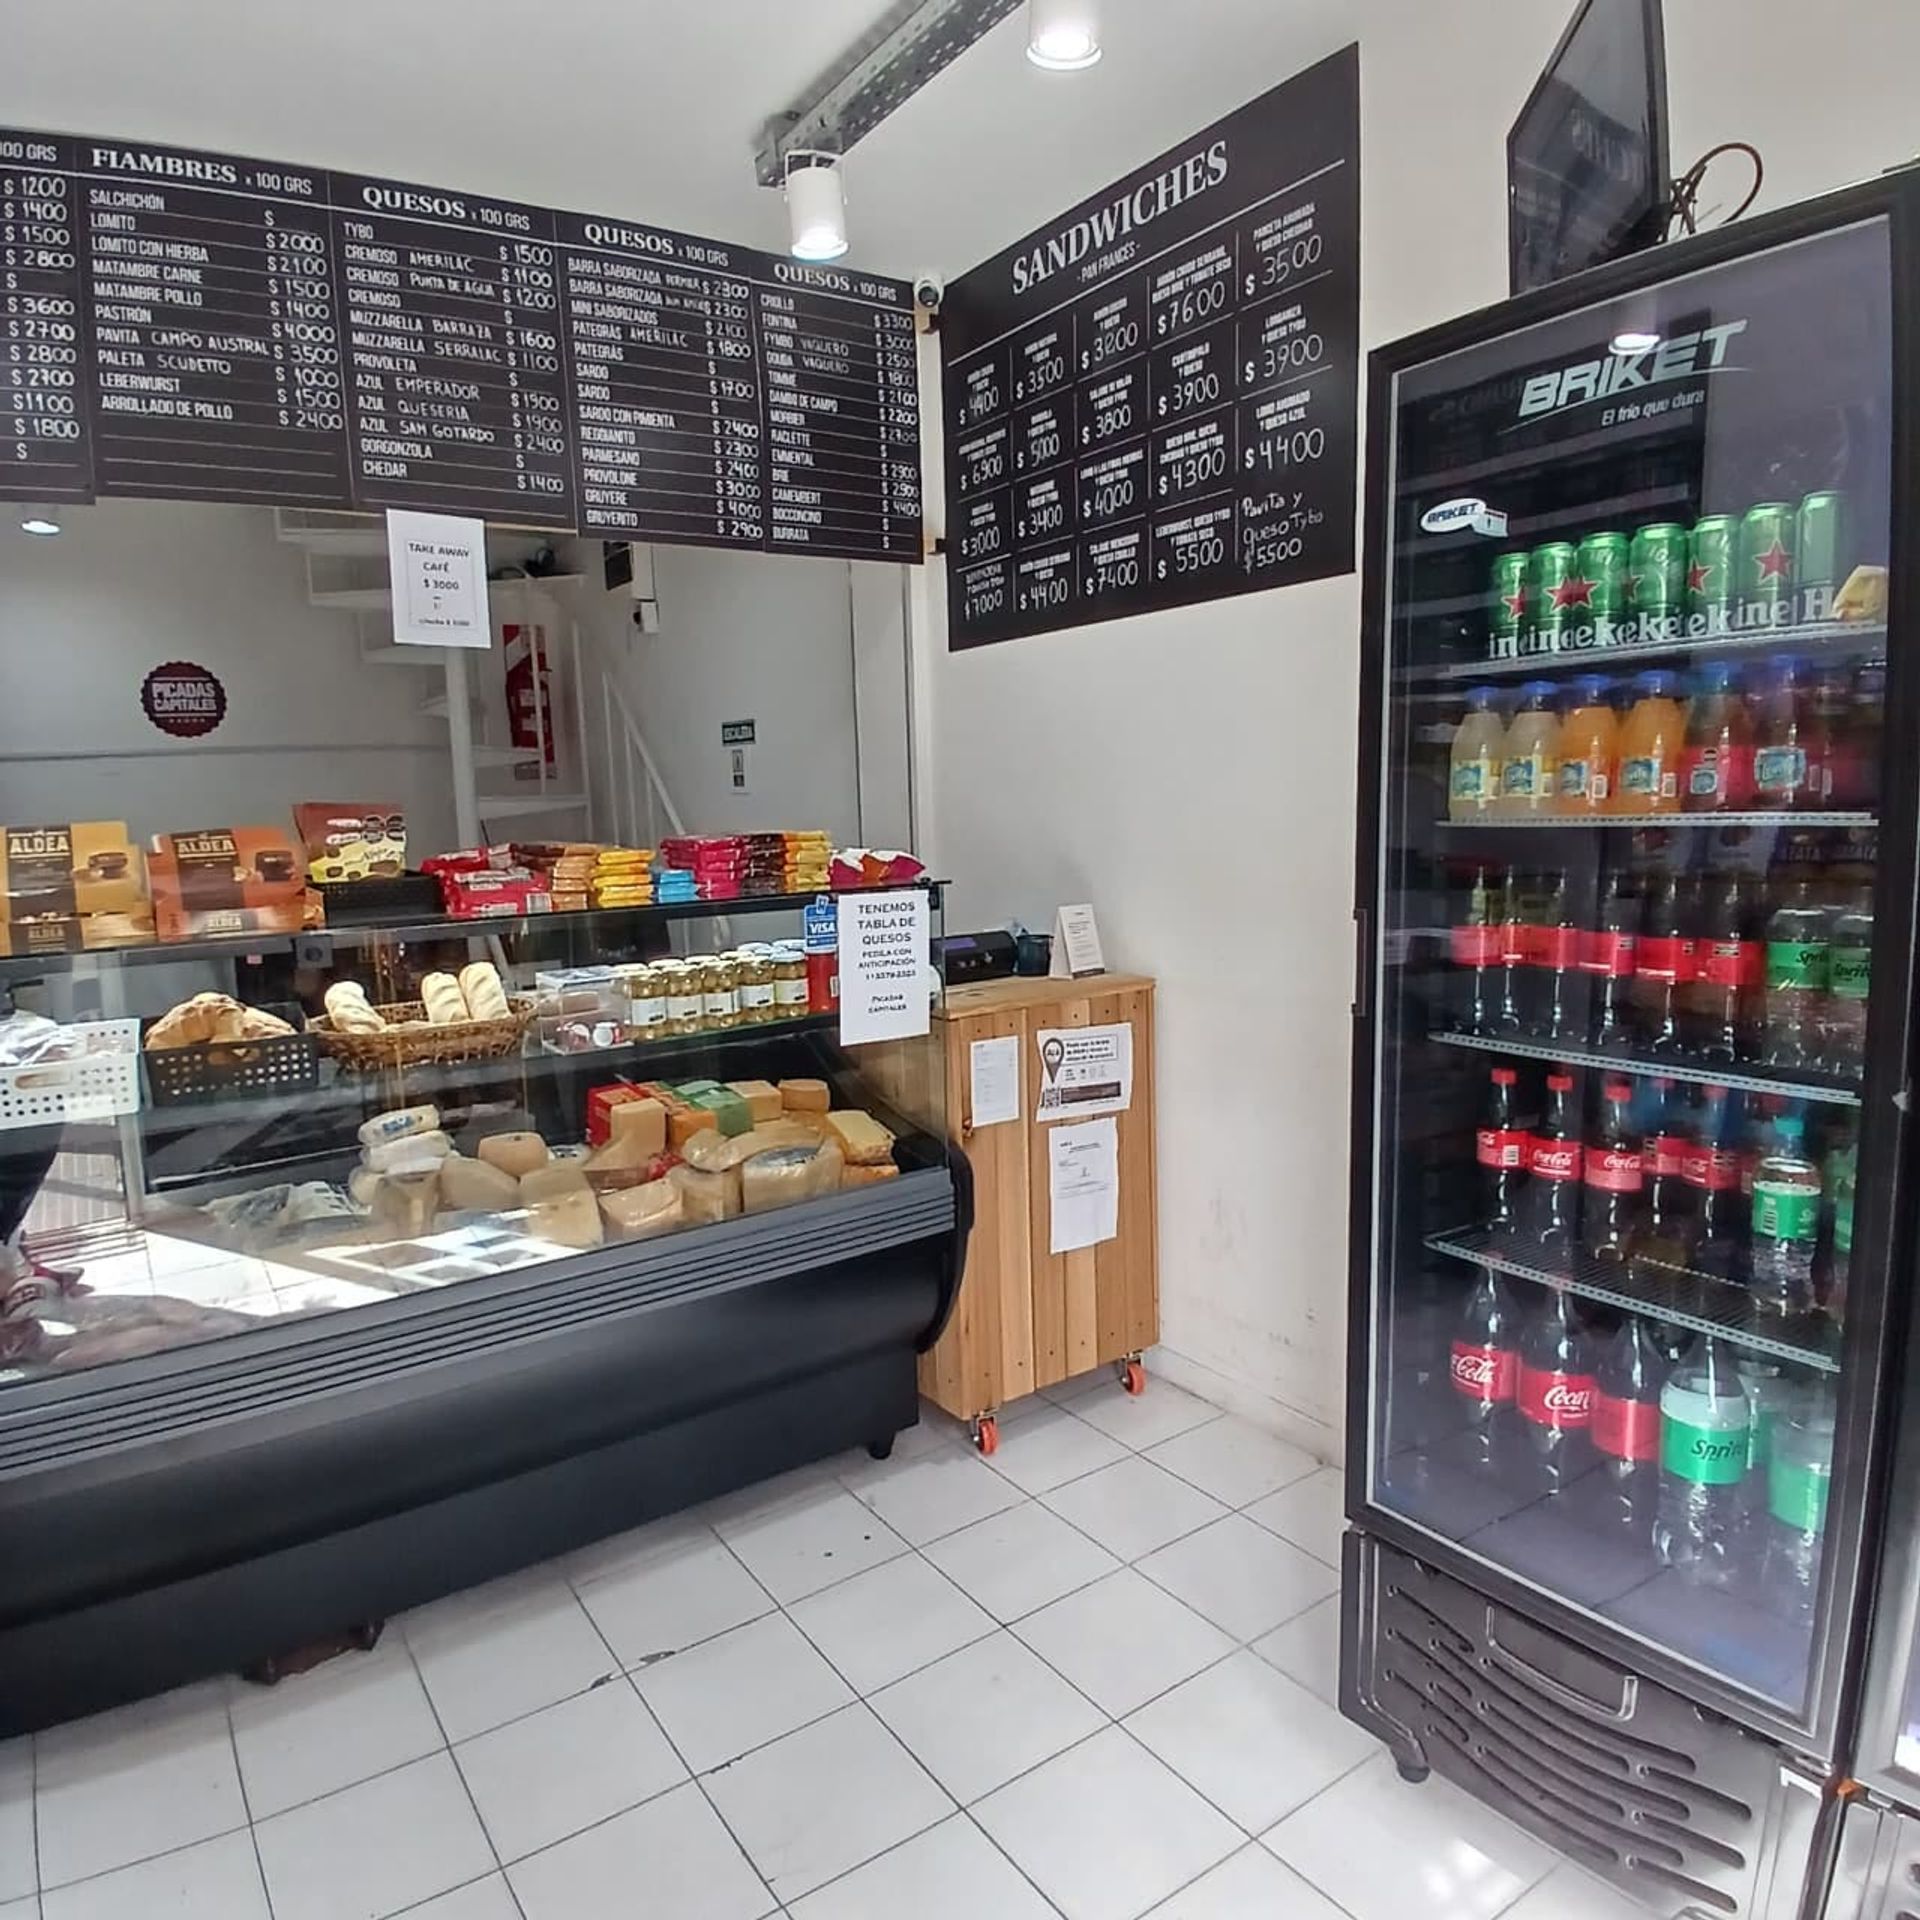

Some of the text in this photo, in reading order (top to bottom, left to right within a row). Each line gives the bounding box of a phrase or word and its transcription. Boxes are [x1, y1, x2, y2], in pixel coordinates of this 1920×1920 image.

[26, 143, 57, 162] GRS
[92, 148, 312, 195] FIAMBRES 100 GRS
[22, 176, 66, 198] 1200
[23, 201, 67, 222] 1400
[362, 186, 530, 231] QUESOS 100 GRS
[1011, 139, 1228, 295] SANDWICHES
[90, 213, 136, 231] LOMITO
[344, 222, 373, 239] TYBO
[23, 226, 70, 245] 1500
[280, 234, 324, 253] 2000
[584, 223, 674, 256] QUESOS
[24, 250, 75, 268] 2800
[92, 236, 209, 262] LOMITO CON HIERBA
[345, 243, 475, 273] CREMOSO AMERILAC
[514, 244, 552, 265] 1500
[281, 257, 327, 276] 2100
[1261, 235, 1322, 285] 3500
[93, 259, 203, 284] MATAMBRE CARNE
[346, 266, 399, 287] CREMOSO
[515, 268, 552, 288] 1100
[774, 263, 850, 291] QUESOS
[94, 281, 203, 306] MATAMBRE POLLO
[285, 279, 330, 299] 1500
[348, 288, 401, 308] CREMOSO
[517, 288, 556, 310] 1200
[714, 280, 749, 299] 2300
[24, 297, 75, 316] 3600
[286, 301, 329, 320] 1400
[714, 303, 749, 320] 2300
[1169, 281, 1226, 329] 7600
[25, 321, 75, 341] 2700
[350, 309, 424, 333] MUZZARELLA
[97, 327, 270, 357] PAVITA CAMPO AUSTRAL
[285, 324, 335, 343] 4000
[352, 332, 425, 353] MUZZARELLA
[520, 332, 557, 350] 1600
[26, 345, 77, 364] 2800
[290, 345, 339, 365] 3500
[718, 341, 751, 359] 1800
[1263, 334, 1323, 377] 3900
[98, 350, 231, 375] PALETA SCUDETTO
[353, 352, 417, 373] PROVOLETA
[523, 353, 558, 372] 1100
[576, 362, 609, 379] SARDO
[1518, 319, 1747, 417] BRIKET
[100, 372, 180, 393] LEBERWURST
[294, 368, 340, 389] 1000
[1028, 356, 1064, 394] 3500
[356, 374, 480, 400] AZUL EMPERADOR
[577, 384, 610, 400] SARDO
[722, 382, 755, 398] 1700
[1173, 373, 1219, 411] 3900
[26, 393, 73, 413] 1100
[102, 393, 233, 420] ARROLLADO DE POLLO
[296, 390, 341, 410] 1500
[358, 395, 385, 411] AZUL
[1602, 409, 1615, 426] El
[1643, 399, 1670, 417] que
[1672, 390, 1705, 409] dura
[297, 411, 343, 431] 2400
[579, 405, 612, 422] SARDO
[613, 409, 633, 424] CON
[1096, 405, 1132, 439] 3800
[33, 417, 80, 438] 1800
[360, 417, 494, 442] AZUL SAN GOTARDO
[724, 421, 759, 438] 2400
[361, 438, 432, 459] GORGONZOLA
[526, 435, 564, 454] 2400
[1261, 428, 1325, 470] 4400
[581, 447, 640, 466] PARMESANO
[363, 460, 407, 478] CHEDAR
[584, 468, 638, 486] PROVOLONE
[1172, 448, 1225, 490] 4300
[530, 476, 564, 493] 1400
[726, 481, 761, 499] 3000
[1095, 480, 1134, 517] 4000
[728, 502, 762, 519] 4000
[1426, 502, 1479, 525] BRIKET
[1243, 520, 1289, 556] Queso
[408, 542, 470, 557] TAKE AWAY
[1176, 538, 1224, 572] 5500
[1098, 561, 1139, 591] 7400
[1031, 578, 1068, 610] 4400
[152, 682, 215, 699] PICADAS
[10, 835, 70, 854] ALDEA
[177, 839, 235, 854] ALDEA
[858, 901, 915, 914] TENEMOS
[809, 921, 836, 934] VISA
[858, 916, 917, 930] TABLA DE
[862, 932, 912, 945] QUESOS
